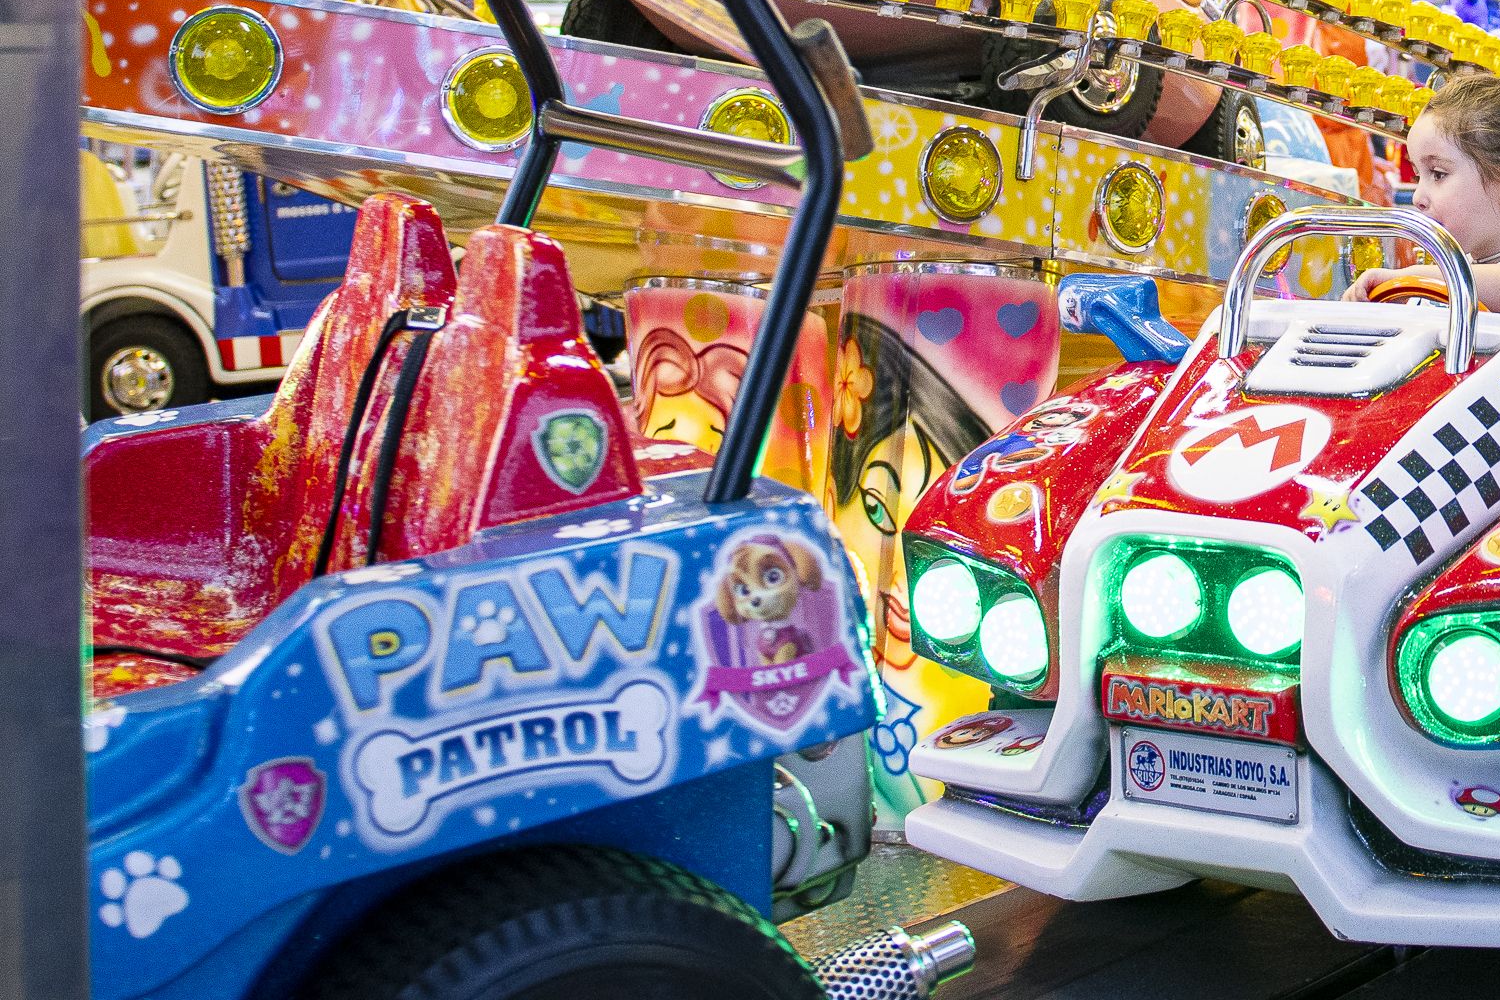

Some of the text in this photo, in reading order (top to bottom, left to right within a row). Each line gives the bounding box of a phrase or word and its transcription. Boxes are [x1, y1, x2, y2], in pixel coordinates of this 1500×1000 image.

[326, 550, 670, 714] PAW
[752, 662, 808, 687] SKYE
[396, 709, 638, 800] PATROL
[1169, 749, 1291, 787] INDUSTRIAS ROYO, S.A.
